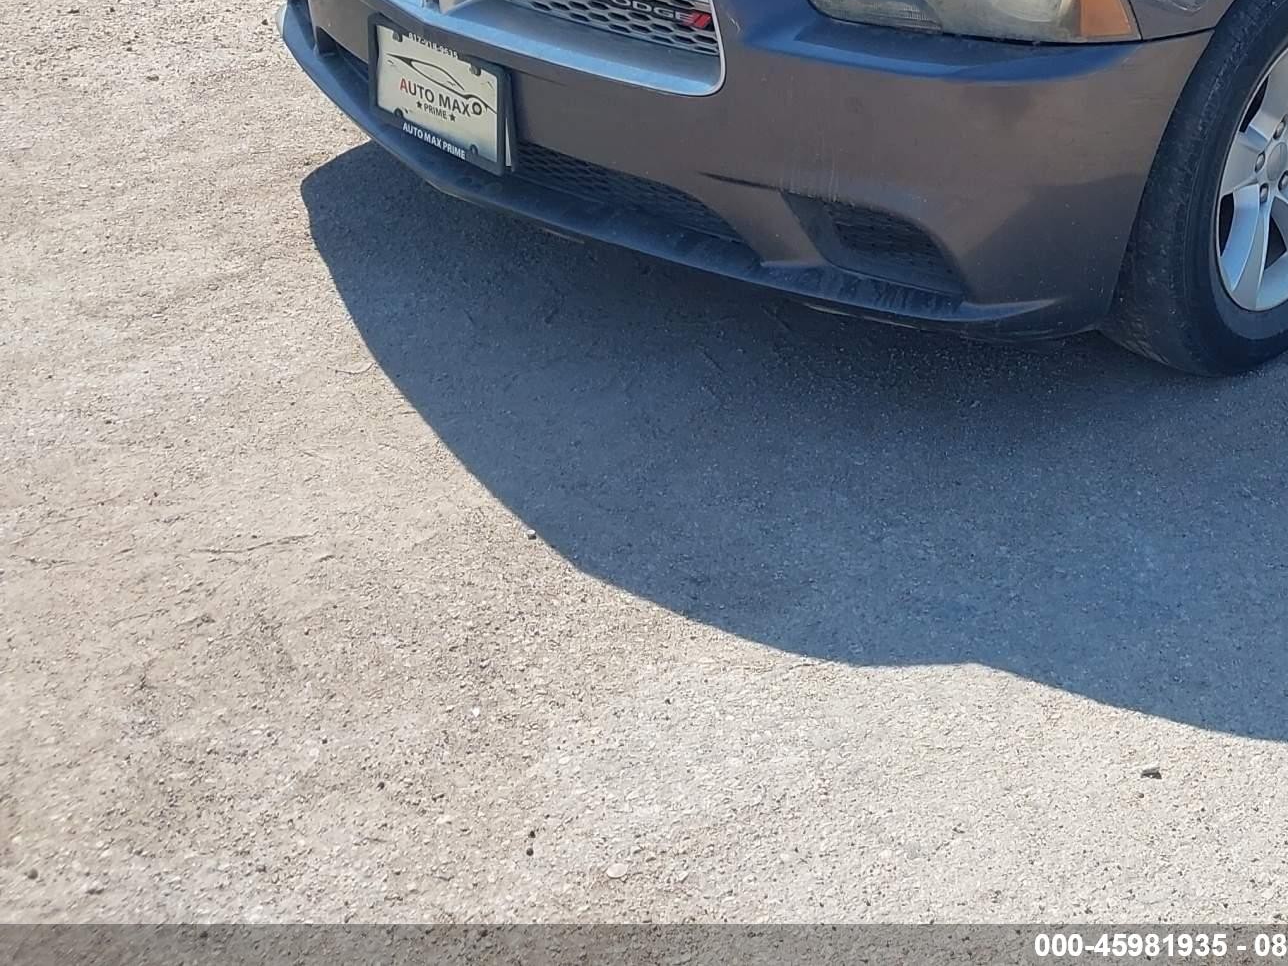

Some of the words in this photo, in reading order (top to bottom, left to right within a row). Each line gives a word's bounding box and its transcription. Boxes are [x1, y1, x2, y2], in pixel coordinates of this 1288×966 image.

[400, 78, 435, 103] AUTO
[423, 102, 448, 120] PRIME
[402, 122, 423, 139] AUTO
[424, 133, 442, 149] MAX
[442, 141, 466, 160] PRIME
